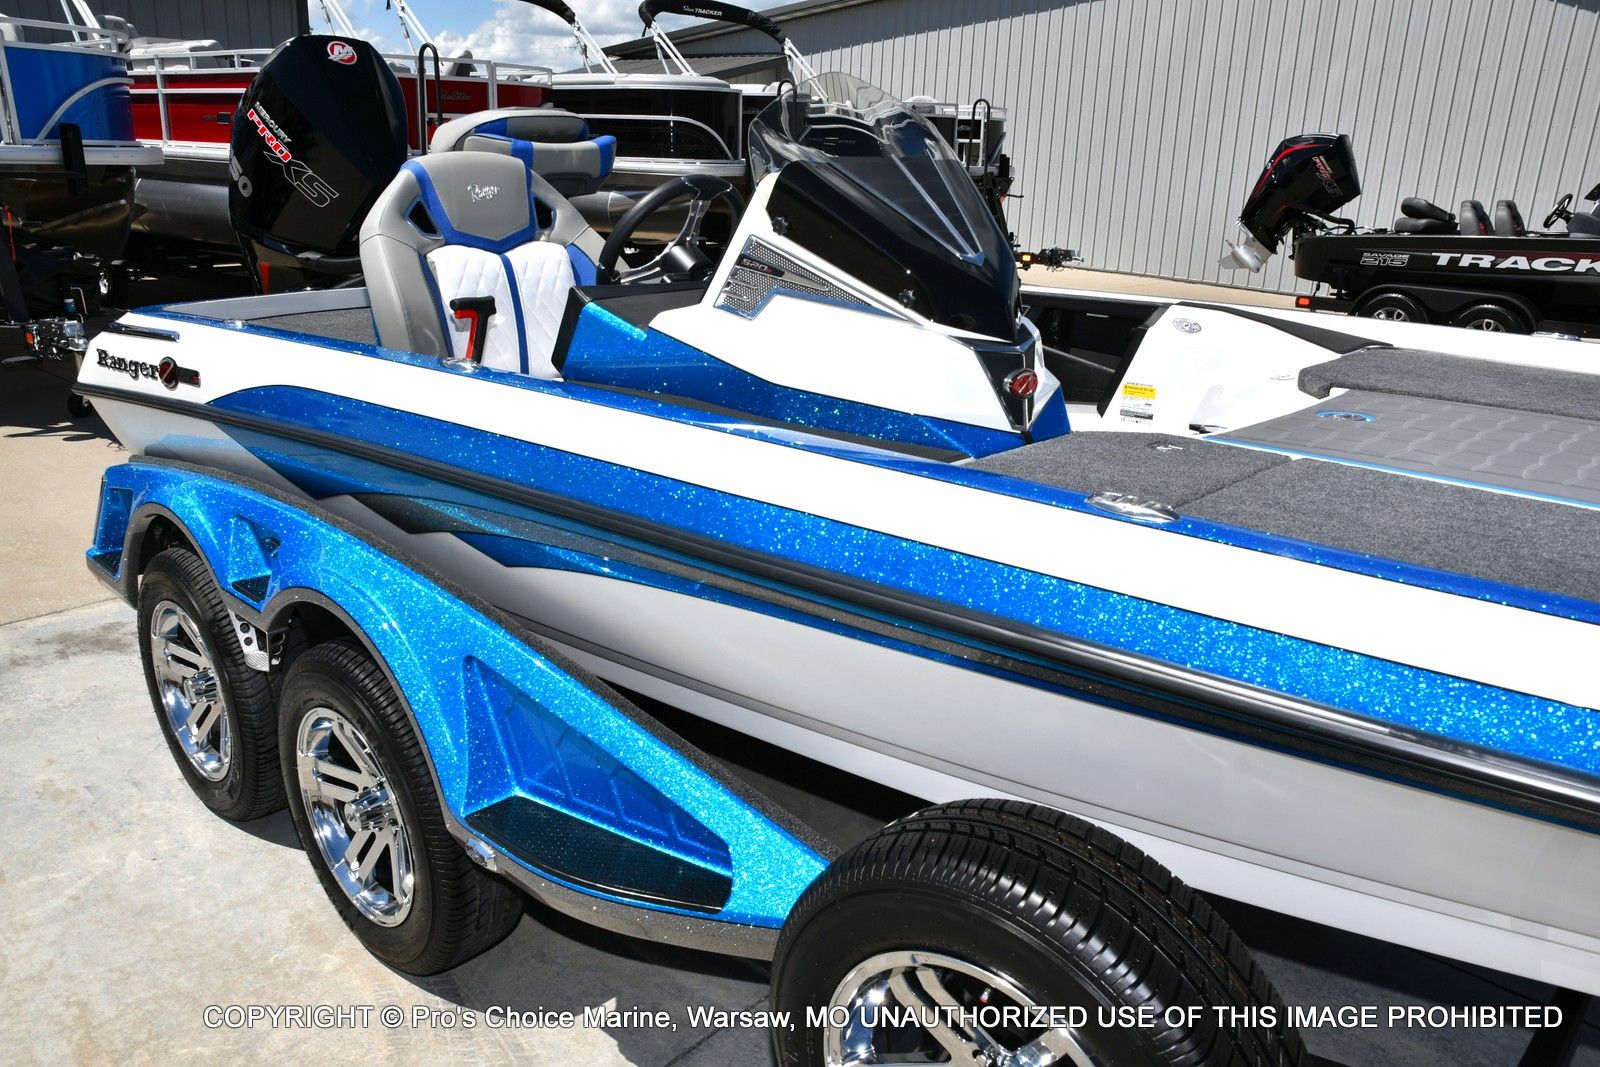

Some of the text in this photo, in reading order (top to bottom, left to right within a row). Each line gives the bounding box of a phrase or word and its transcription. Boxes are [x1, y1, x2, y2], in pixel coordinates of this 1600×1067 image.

[695, 8, 723, 16] TRACKER
[254, 101, 292, 143] MERCURY
[247, 108, 339, 208] PRO XS
[467, 183, 500, 202] Ranger
[1359, 258, 1409, 267] 215
[1431, 252, 1600, 273] TRACK
[96, 348, 160, 381] Ranger
